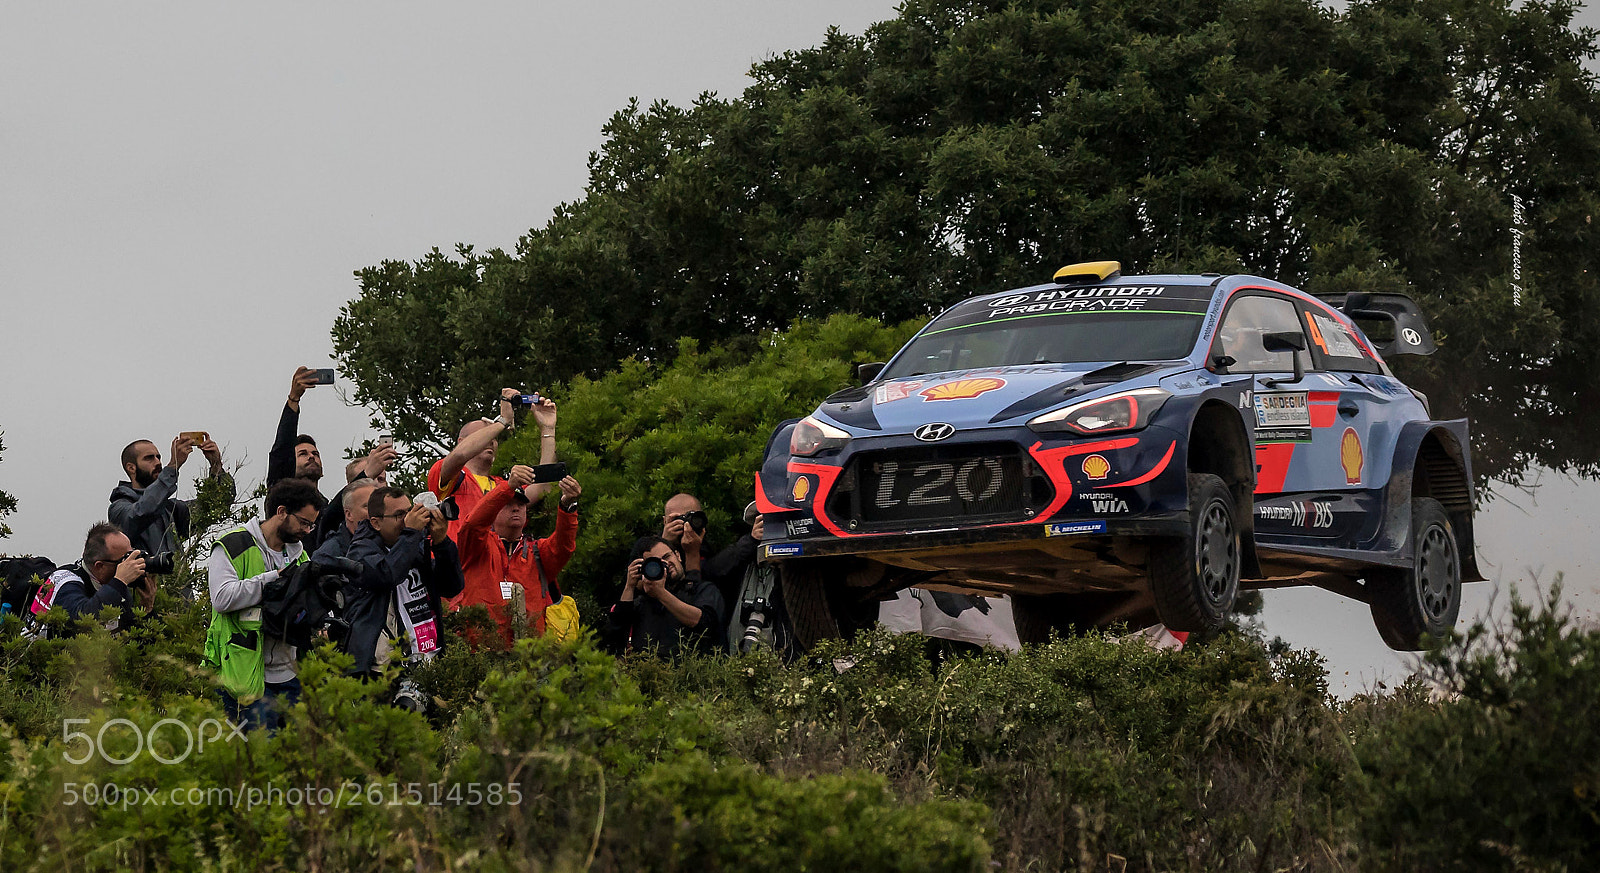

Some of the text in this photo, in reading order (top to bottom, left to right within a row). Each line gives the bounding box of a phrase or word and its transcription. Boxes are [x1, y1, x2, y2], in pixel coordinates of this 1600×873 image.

[1034, 286, 1165, 301] HYUNDAI
[1304, 311, 1329, 355] 4
[1239, 389, 1253, 409] N
[1263, 396, 1305, 410] SARDEGNA
[1260, 499, 1334, 529] HYUNDAI MOBIS
[1061, 524, 1102, 533] MICHELIN
